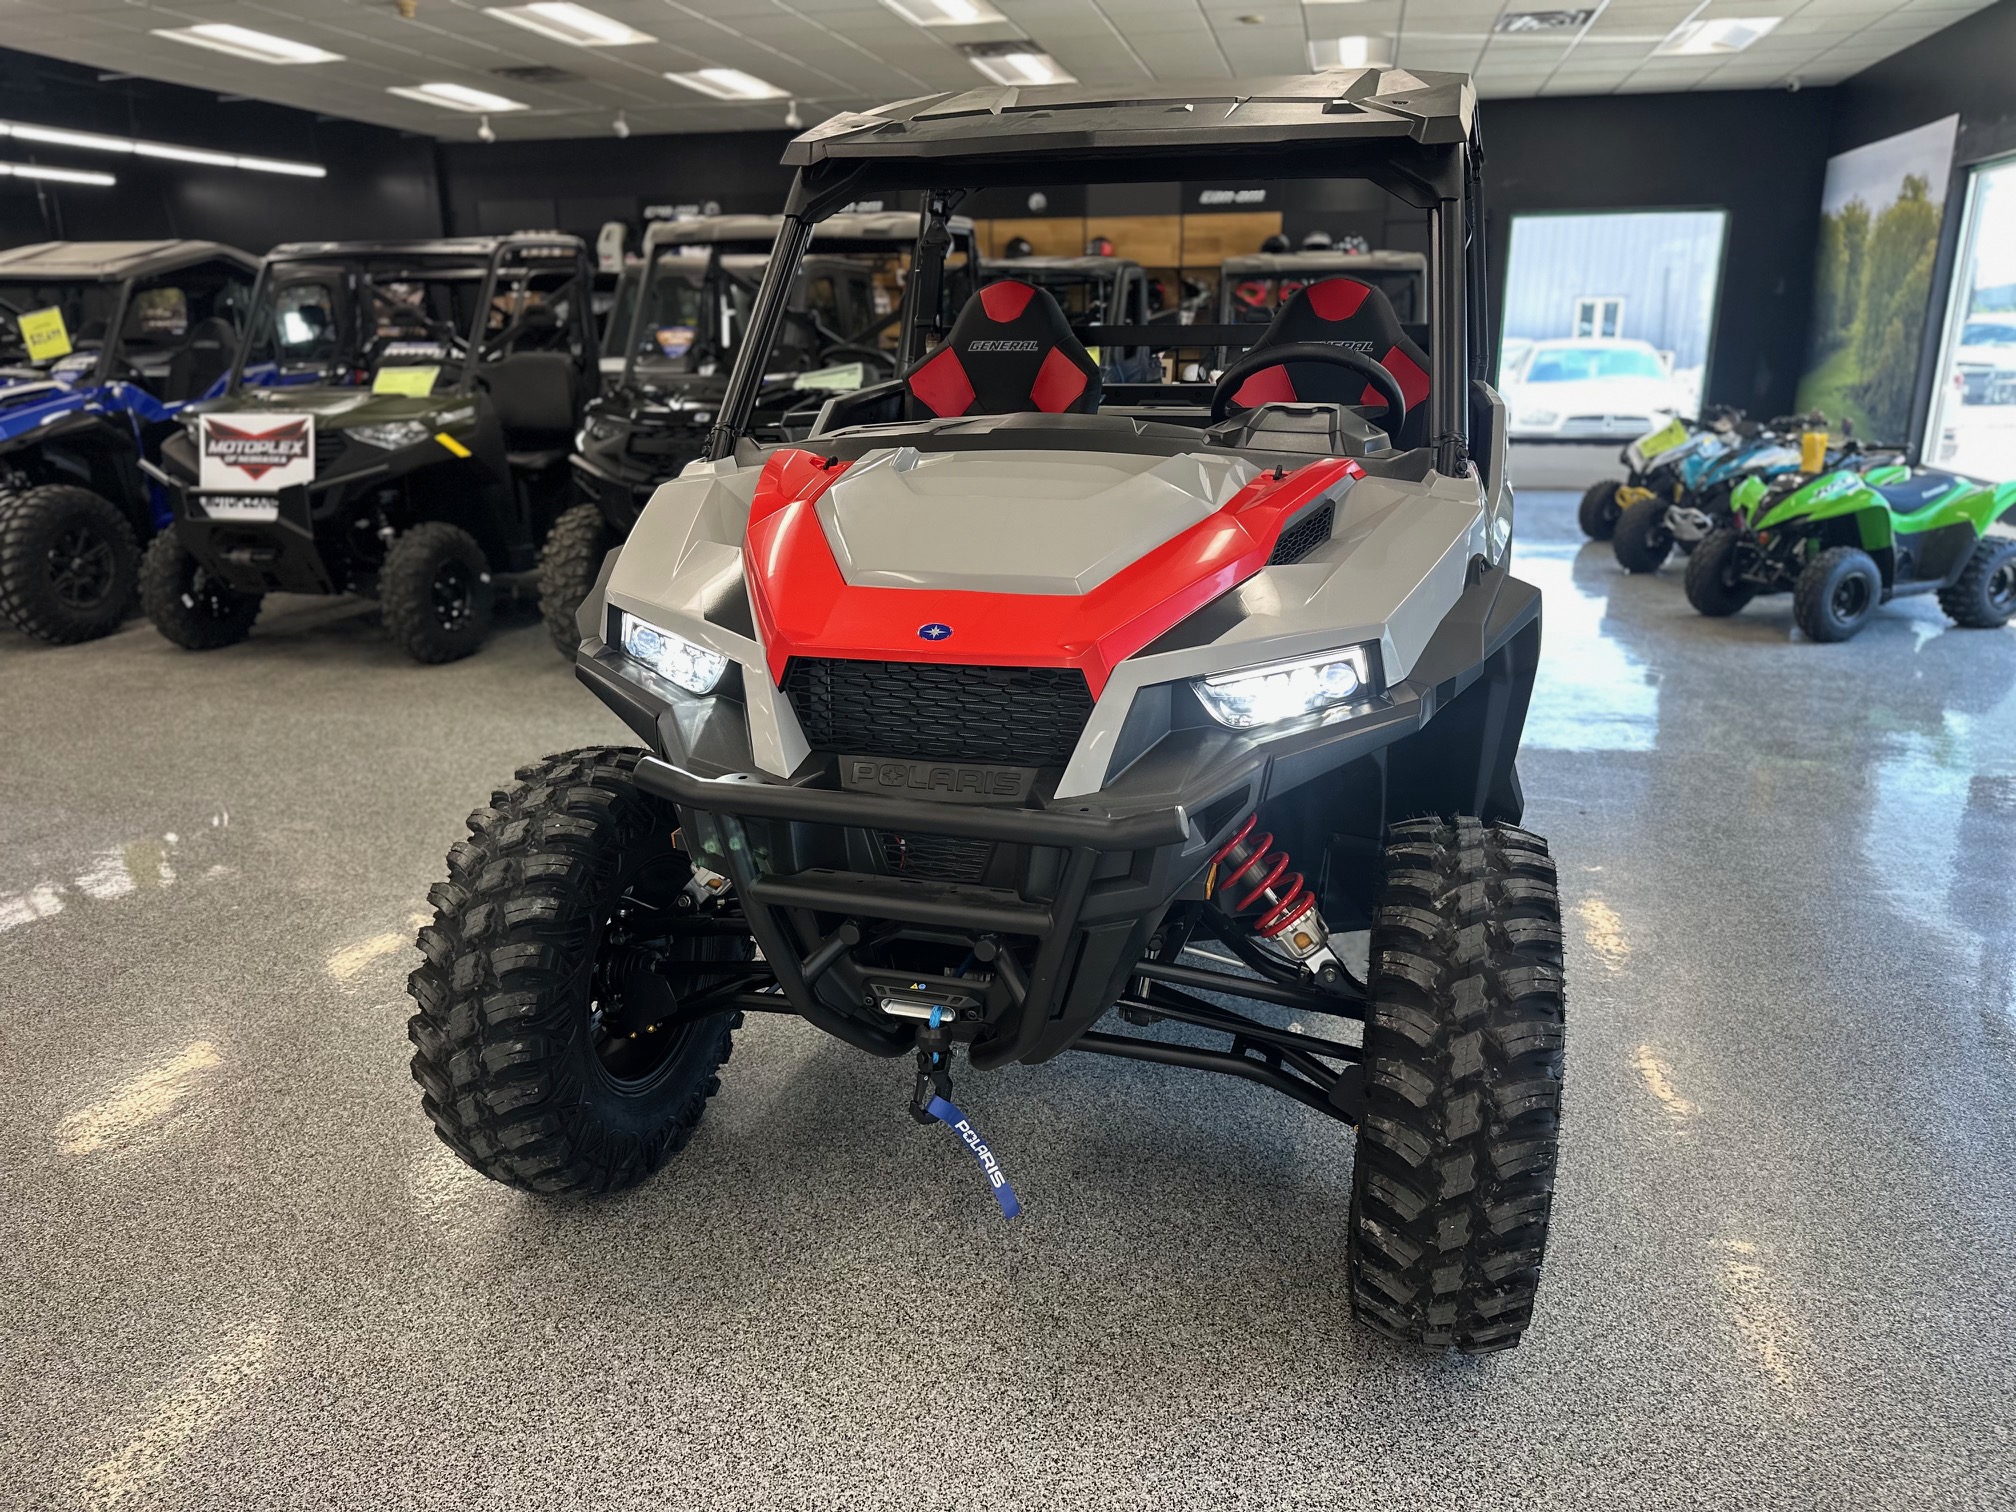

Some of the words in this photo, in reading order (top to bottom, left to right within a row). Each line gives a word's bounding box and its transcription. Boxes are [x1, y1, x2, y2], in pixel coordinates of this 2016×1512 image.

[968, 341, 1038, 351] GENERAL
[207, 440, 305, 454] MOTOPLEX
[851, 762, 1022, 796] POLARIS
[955, 1120, 1006, 1188] POLARIS
